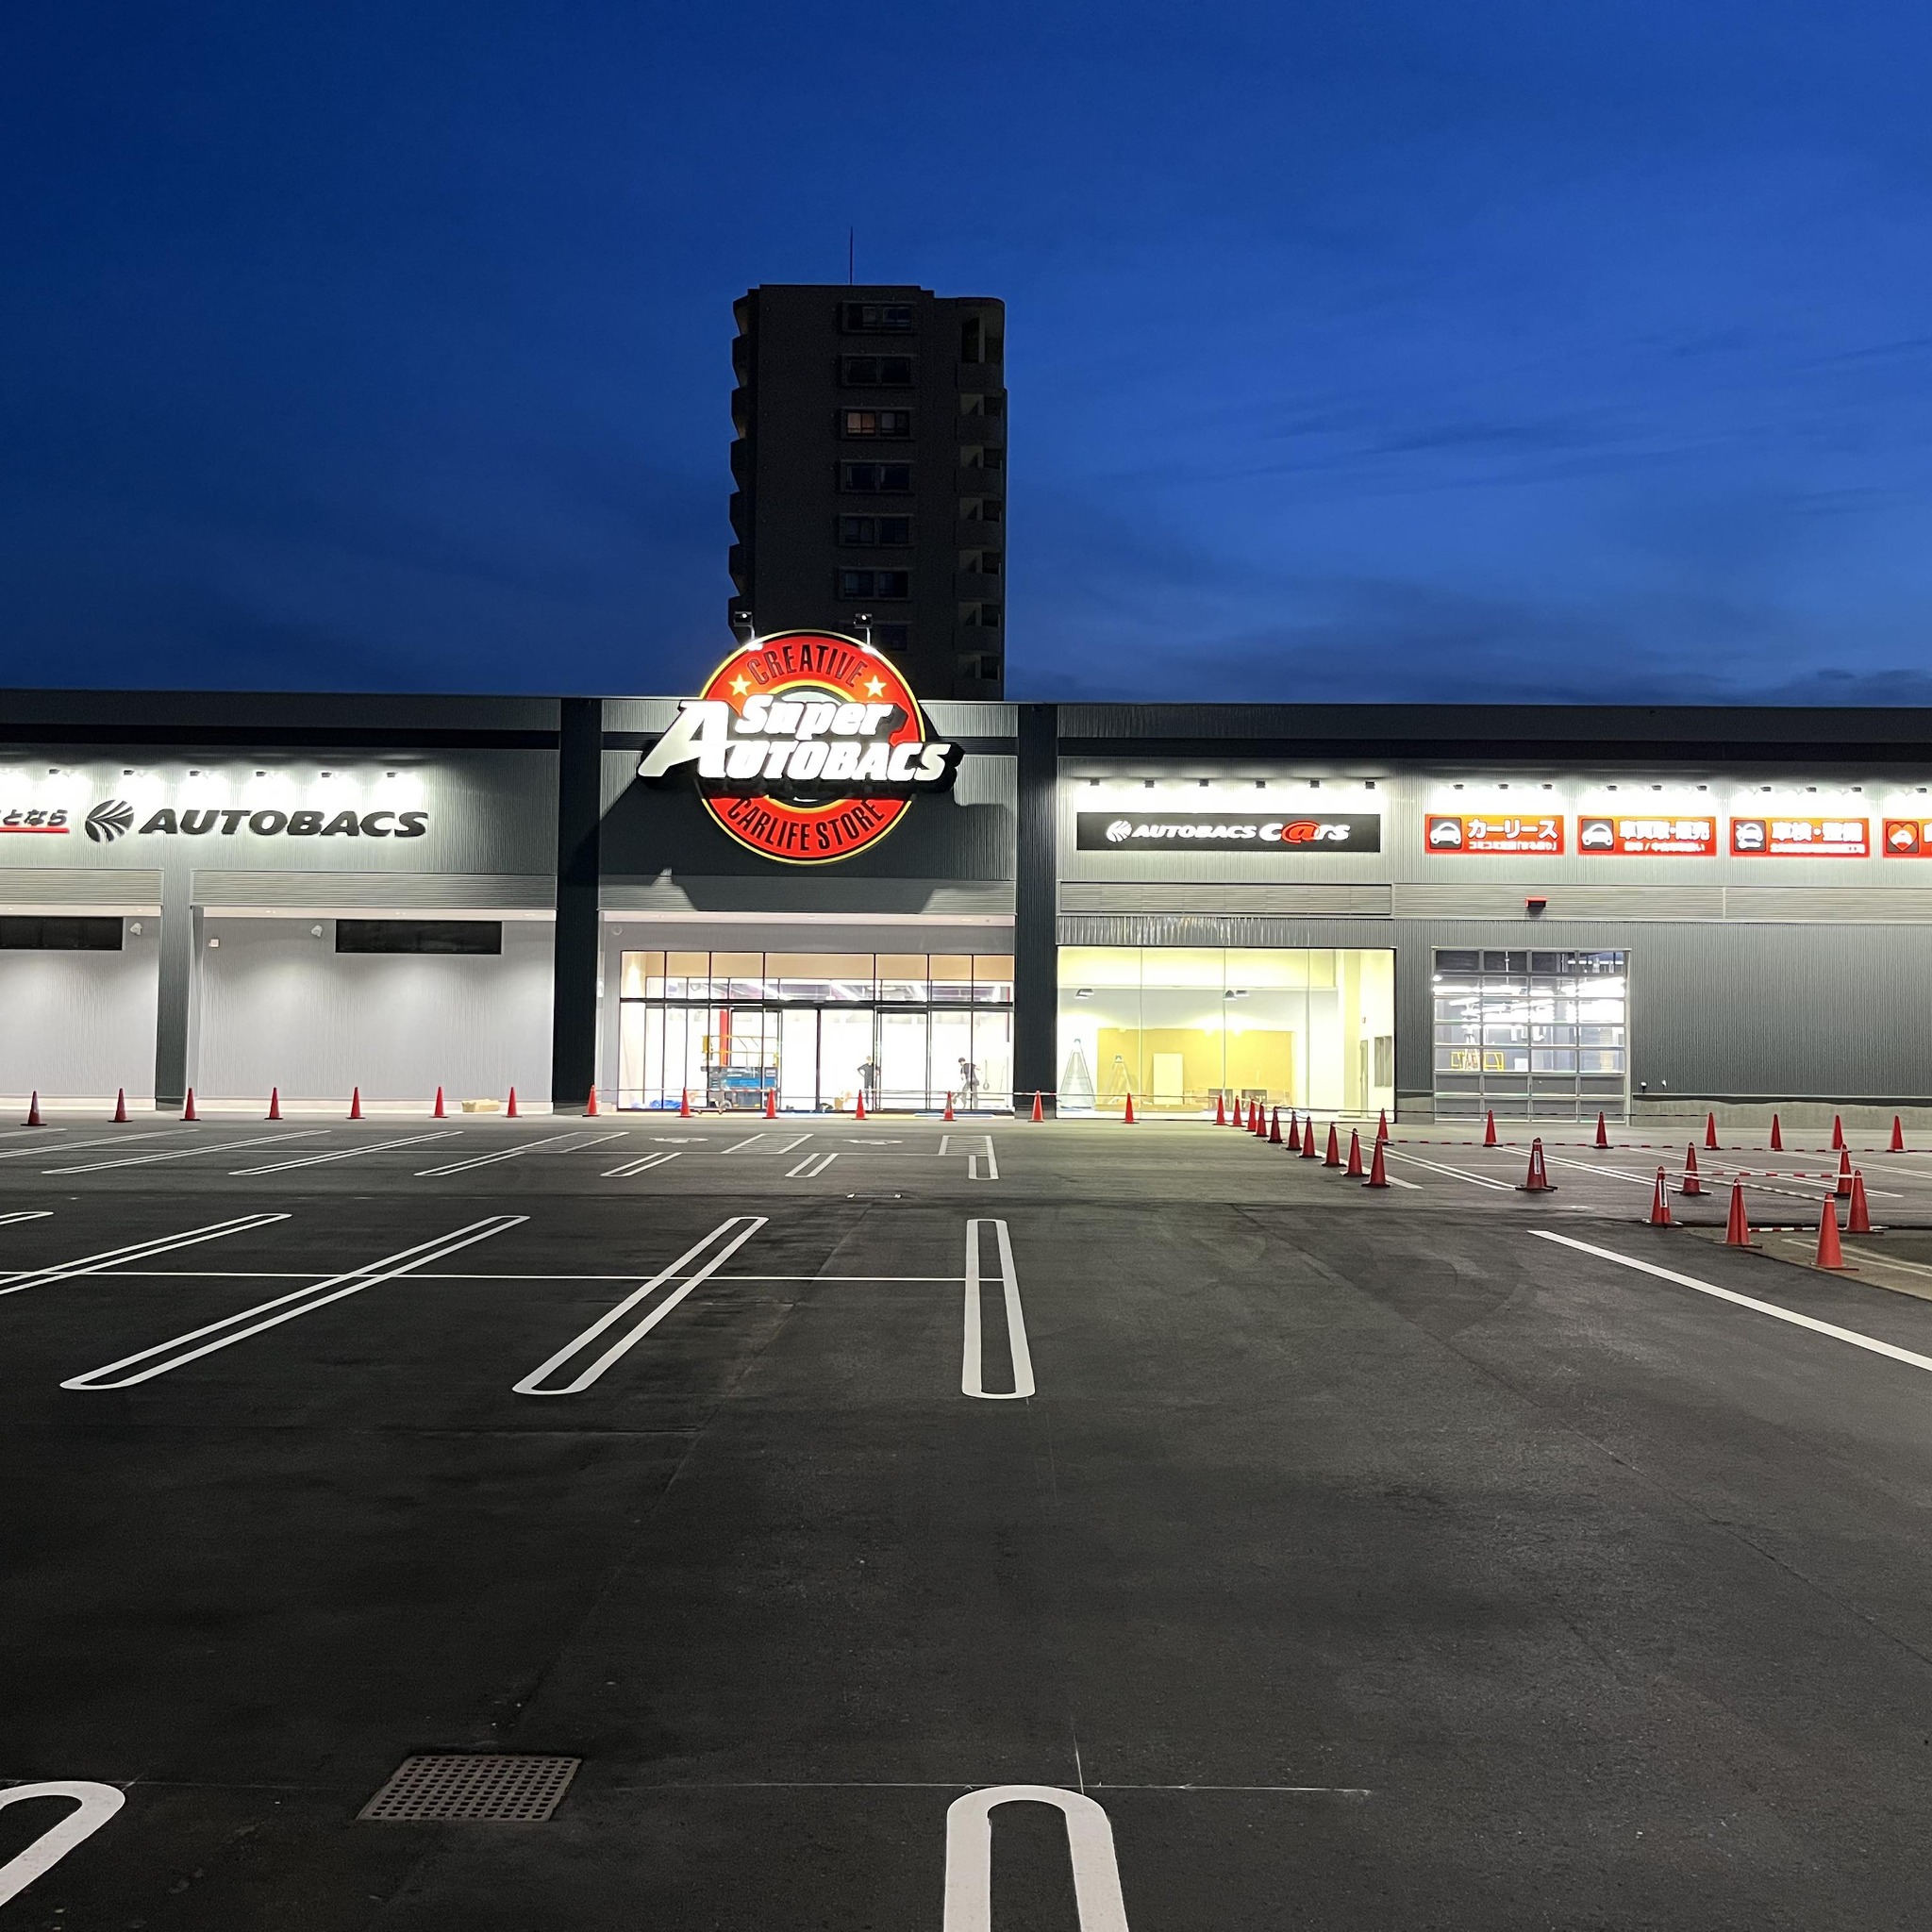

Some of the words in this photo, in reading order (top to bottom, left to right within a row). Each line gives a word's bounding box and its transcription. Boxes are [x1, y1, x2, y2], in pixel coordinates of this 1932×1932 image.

[746, 643, 868, 688] CREATIVE
[735, 693, 894, 741] Super
[638, 699, 951, 781] AUTOBACS
[0, 808, 68, 826] となら
[138, 808, 429, 838] AUTOBACS
[727, 799, 809, 851] CARLIFE
[817, 802, 885, 849] STORE
[1131, 824, 1257, 840] AUTOBACS
[1467, 818, 1558, 840] カーリース
